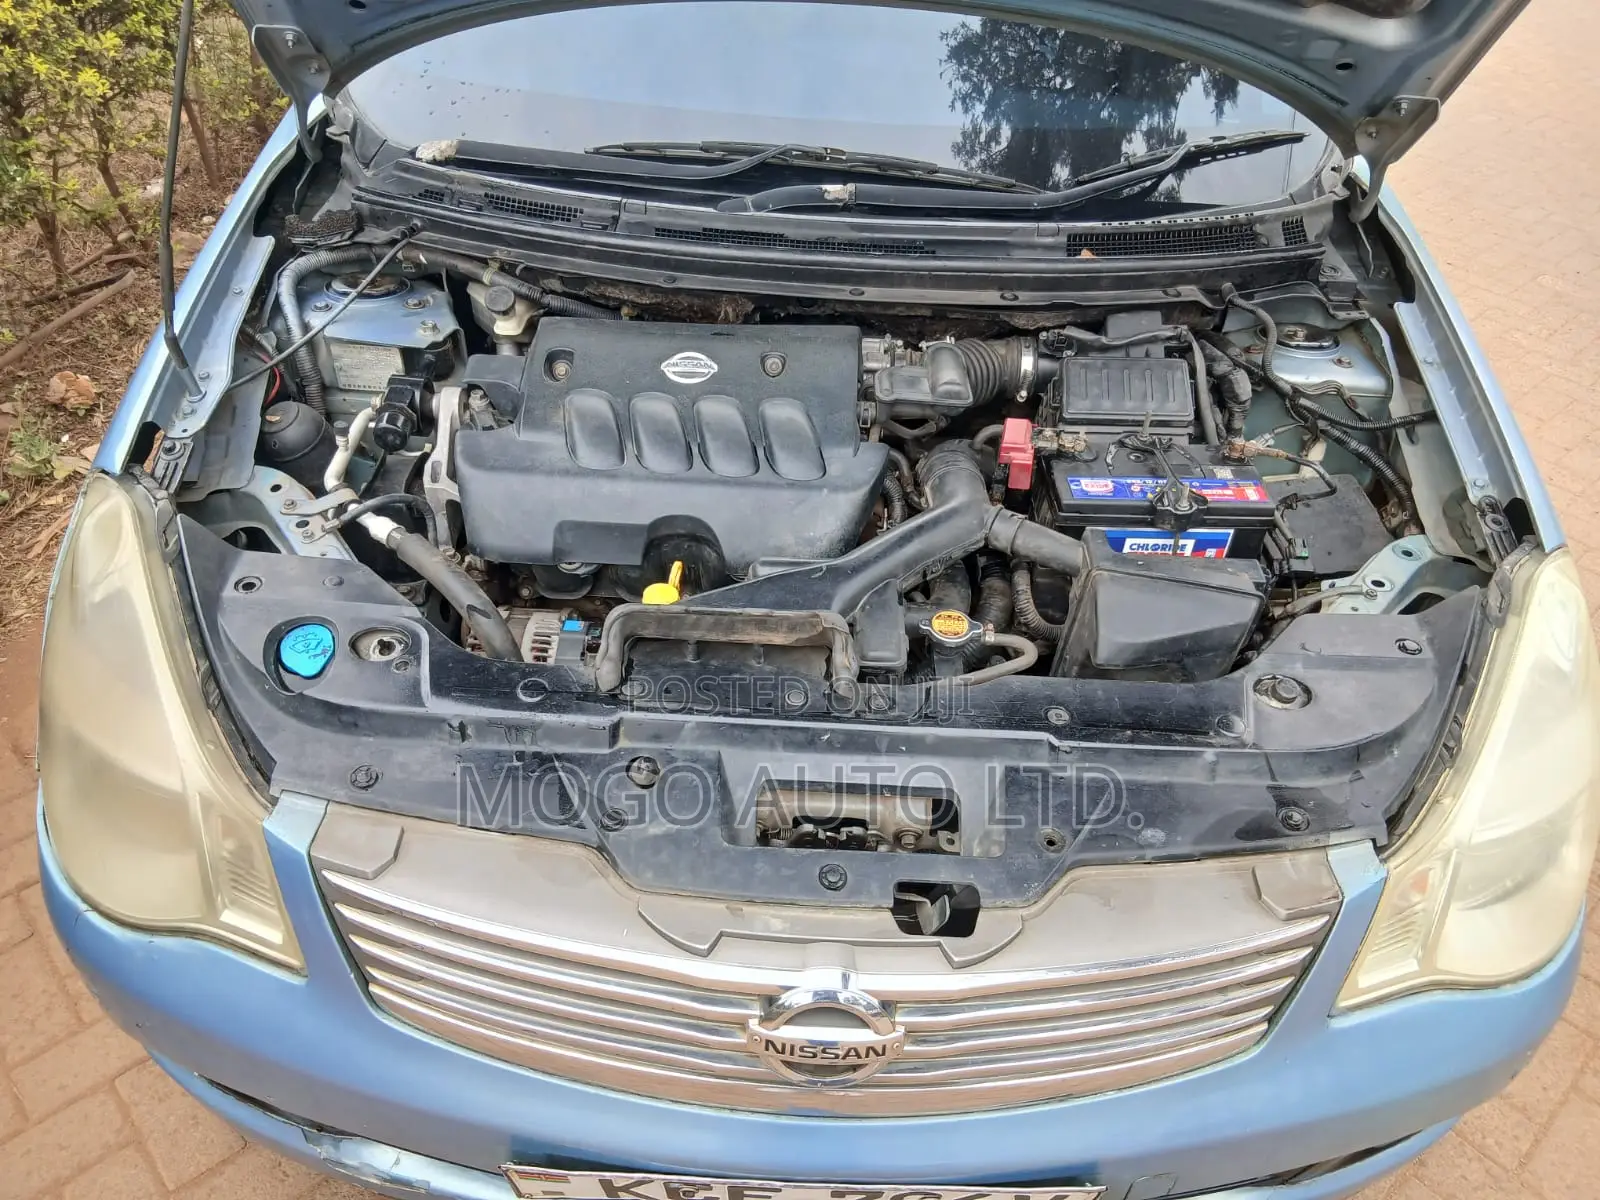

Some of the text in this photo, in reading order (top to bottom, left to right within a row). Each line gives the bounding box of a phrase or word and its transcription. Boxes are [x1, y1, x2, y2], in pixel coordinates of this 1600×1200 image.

[664, 361, 716, 370] NISSAN
[1129, 543, 1188, 552] CHLORIE
[764, 1039, 887, 1060] NISSAN
